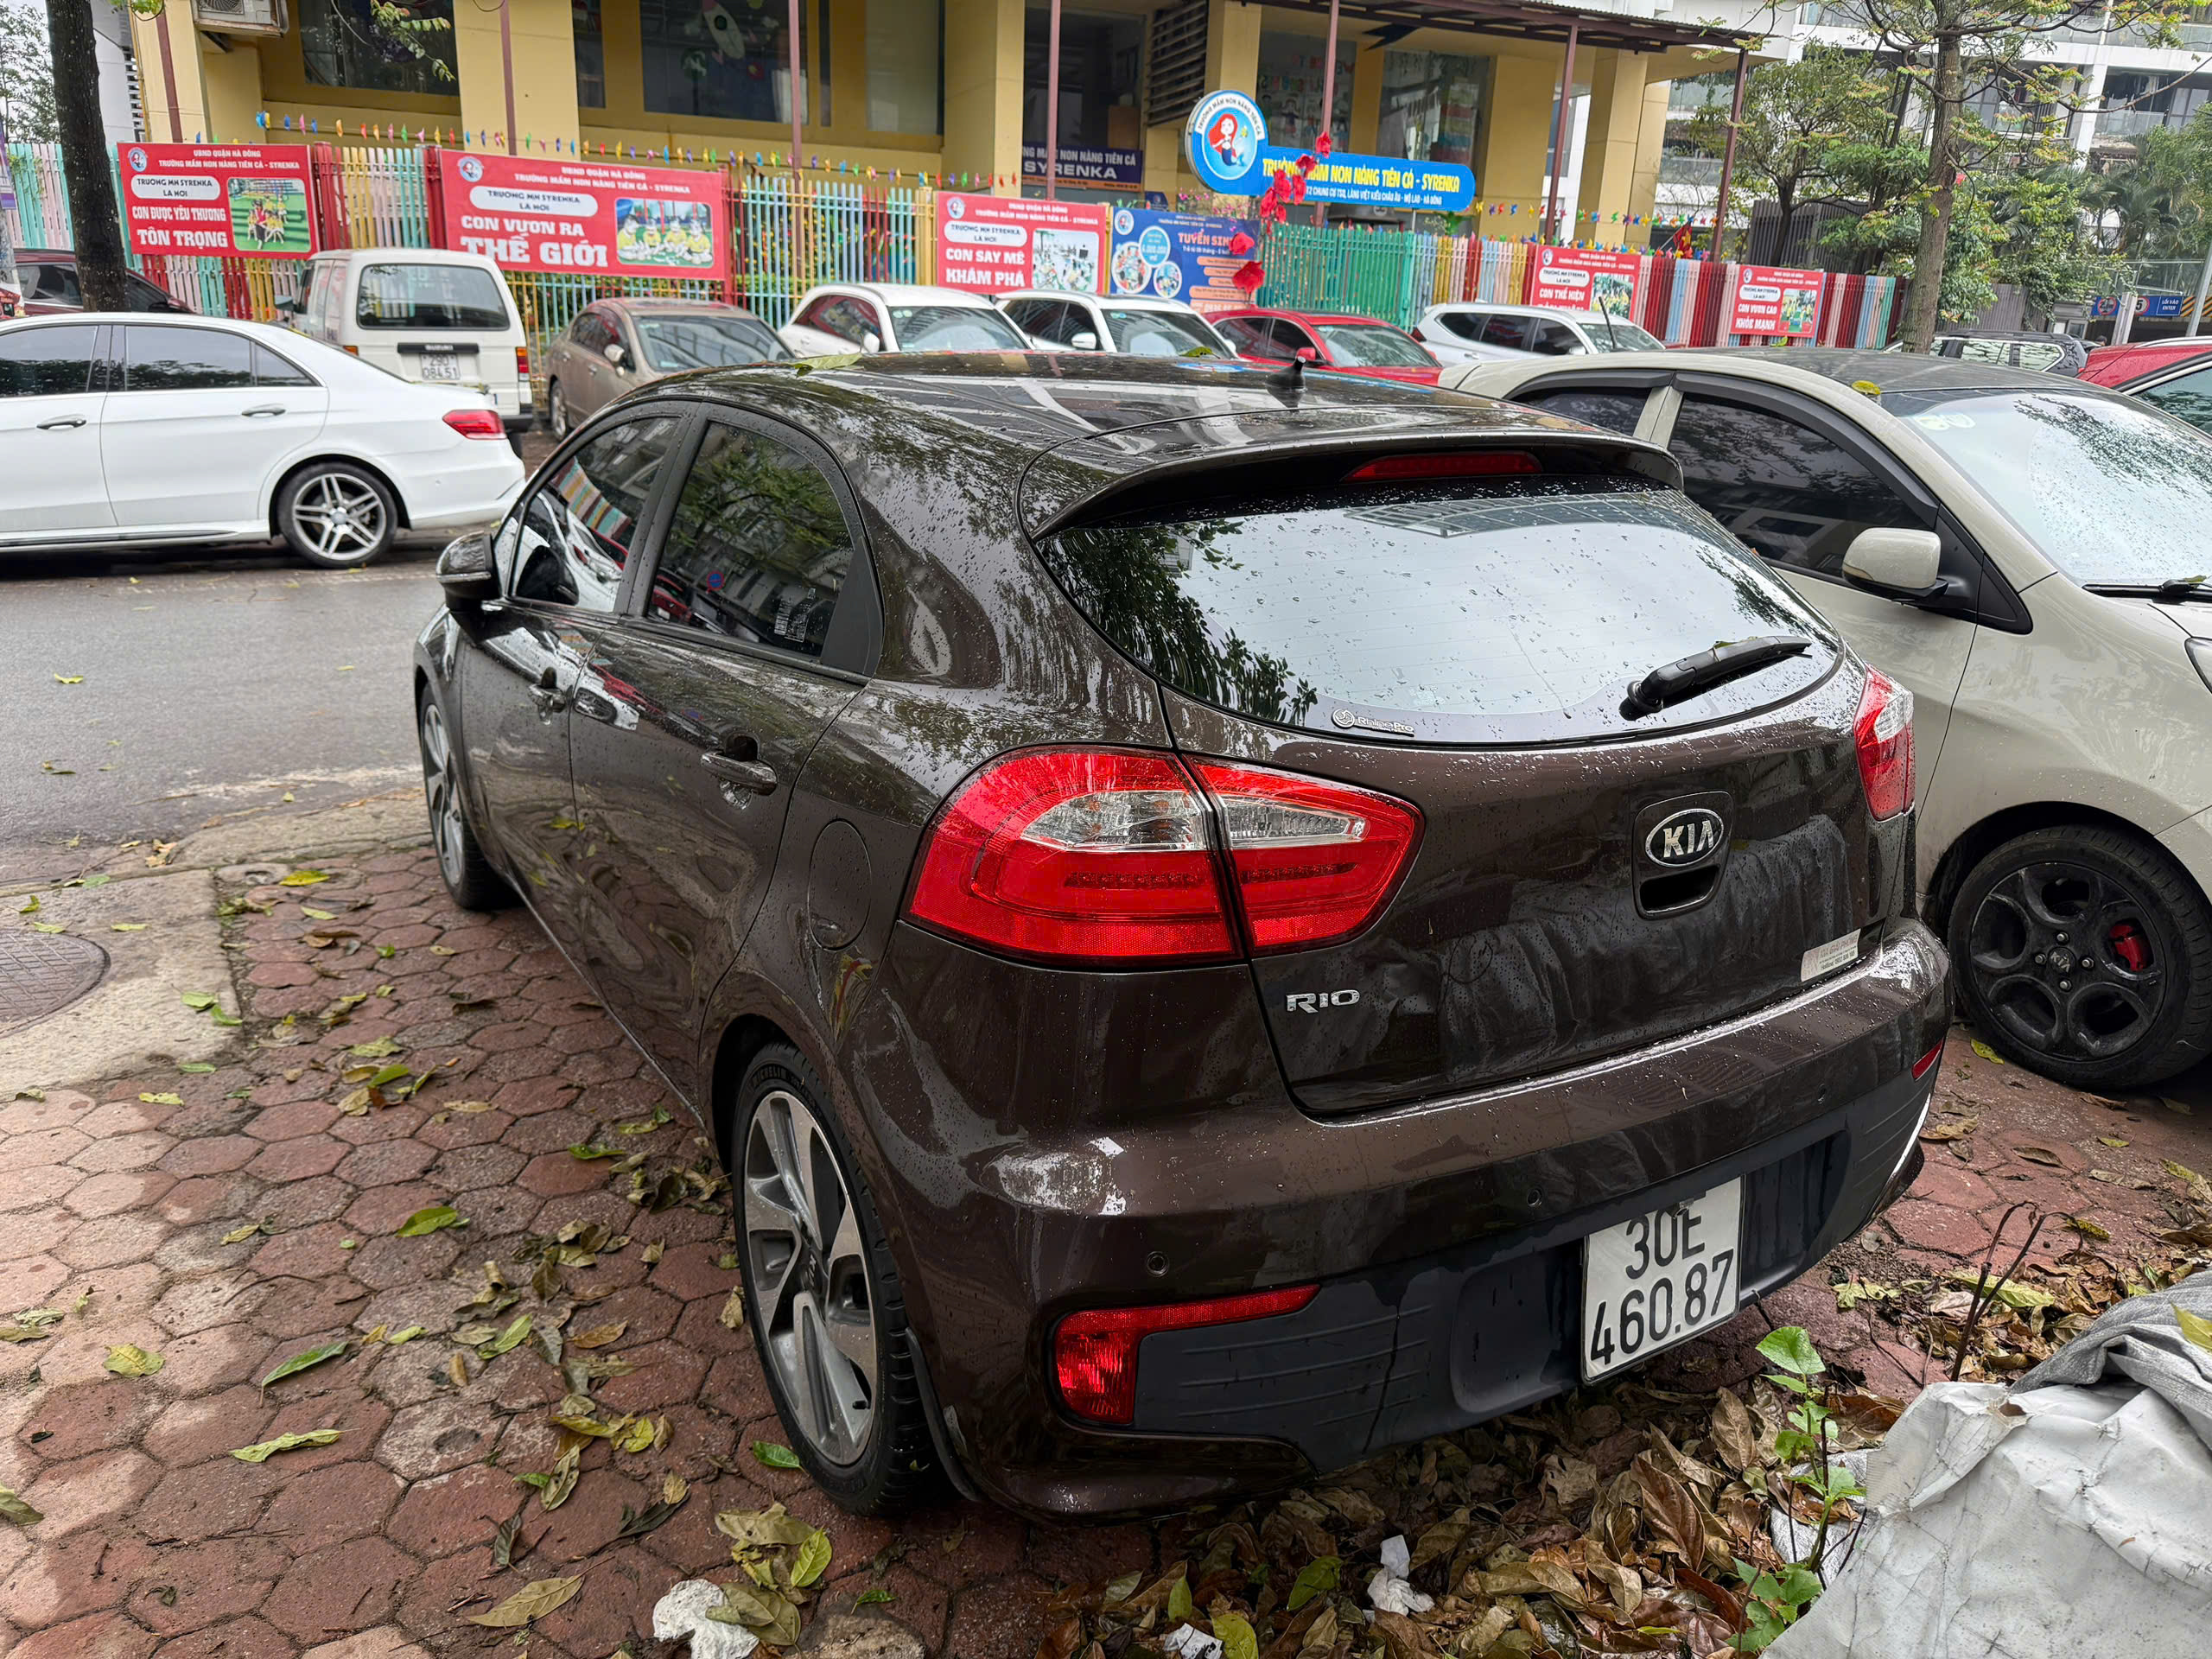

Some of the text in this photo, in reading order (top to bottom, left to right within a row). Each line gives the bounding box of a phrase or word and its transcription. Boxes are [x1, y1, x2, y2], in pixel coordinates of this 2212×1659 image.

[1060, 150, 1078, 162] NON
[1080, 149, 1103, 163] NÀNG
[1105, 152, 1122, 164] TIÊN
[1125, 154, 1135, 166] CÁ
[1024, 161, 1116, 179] SYRENKA
[1332, 164, 1352, 183] NON
[1354, 164, 1379, 186] NÀNG
[1382, 167, 1401, 188] TIÊN
[1402, 168, 1414, 188] CÁ
[1421, 173, 1460, 193] SYRENKA
[132, 206, 149, 219] CON
[149, 207, 173, 222] ĐƯỢC
[173, 205, 190, 220] YÊU
[461, 216, 499, 231] CON
[559, 222, 585, 237] RA
[137, 226, 228, 249] TÔN TRỌNG
[1211, 235, 1232, 246] SIN
[461, 233, 608, 267] THẾ GIỚI
[946, 247, 1025, 264] CON SAY MÊ
[946, 266, 1025, 287] KHÁM PHÁ
[1540, 288, 1554, 298] CON
[1662, 820, 1714, 857] KIA
[1286, 990, 1360, 1013] RIO
[1625, 1209, 1706, 1280] 30E
[1590, 1248, 1734, 1365] 460.87
